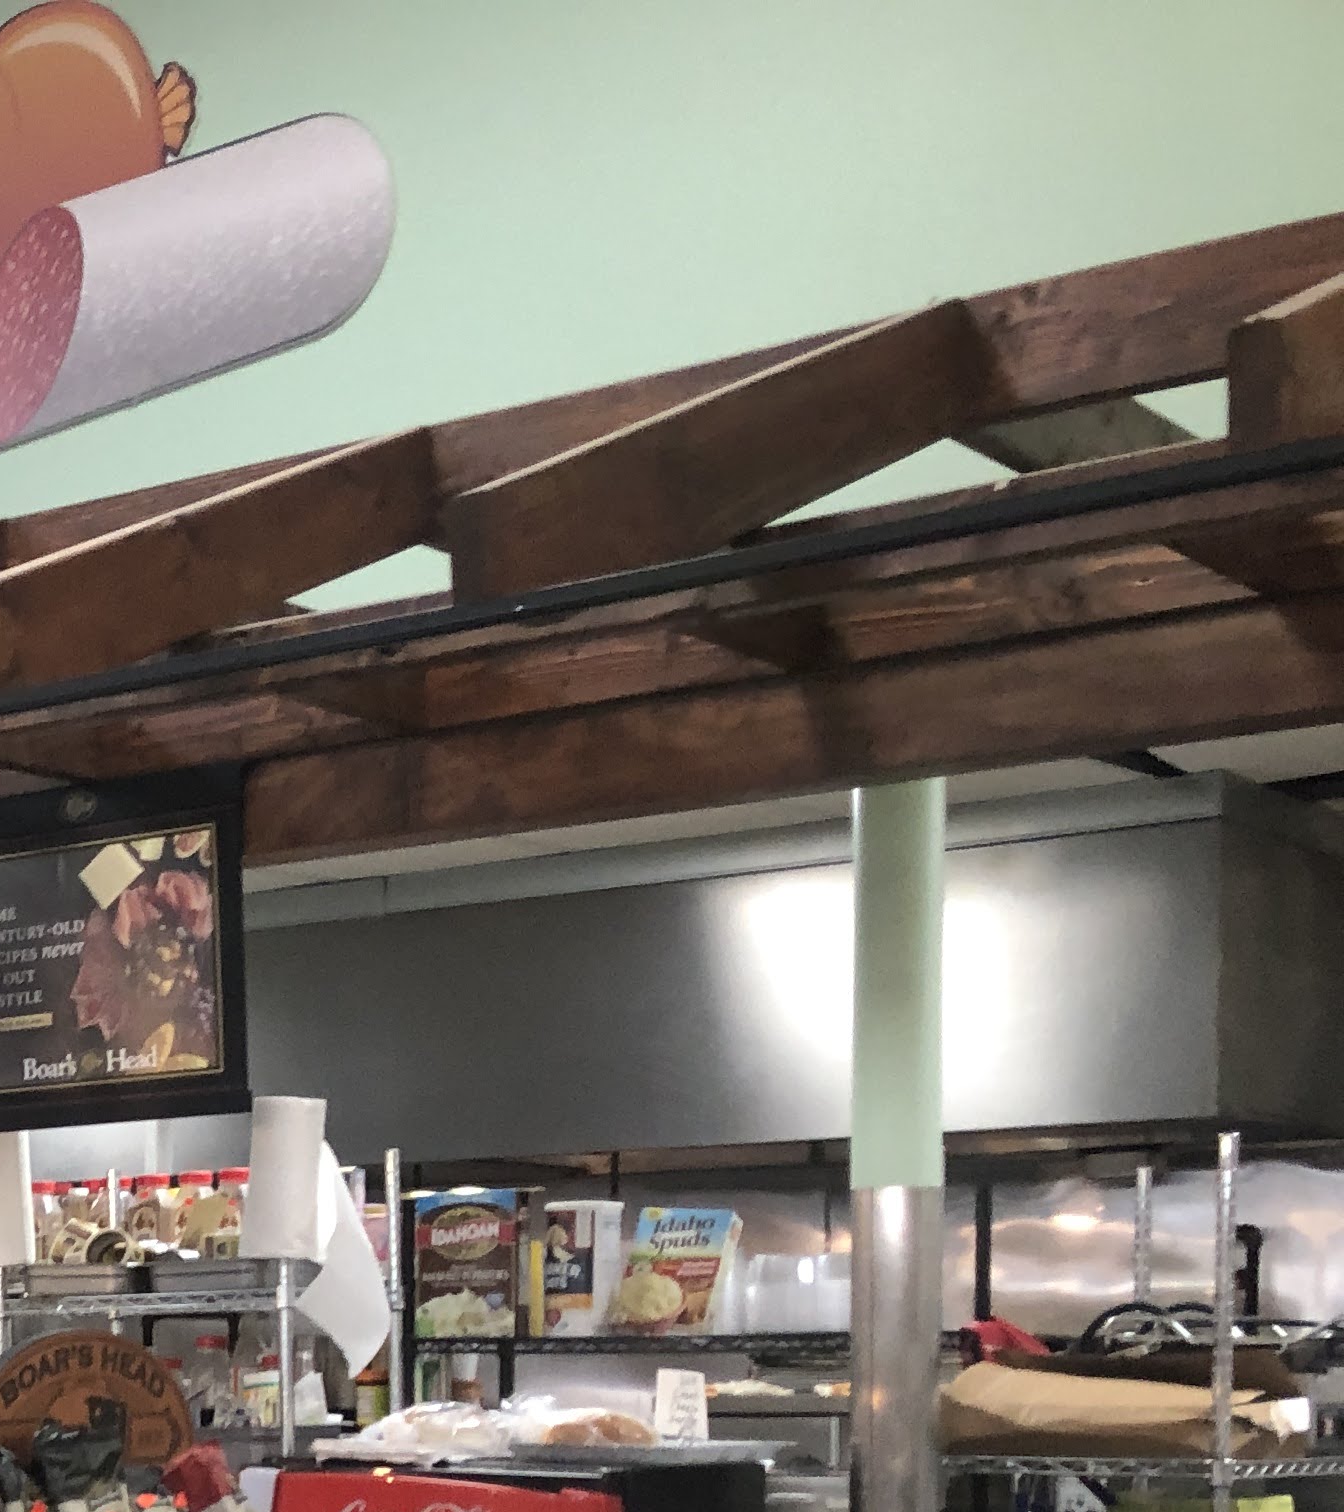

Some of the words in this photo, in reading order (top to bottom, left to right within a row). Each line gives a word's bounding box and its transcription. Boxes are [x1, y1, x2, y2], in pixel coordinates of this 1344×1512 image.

[41, 941, 85, 961] never
[2, 968, 36, 986] OUT
[22, 1053, 77, 1081] Boar's
[105, 1044, 158, 1073] Head
[653, 1215, 717, 1235] Idaho
[649, 1230, 711, 1256] Spuds
[0, 1343, 95, 1410] BOAR'S
[100, 1346, 165, 1398] HEAD
